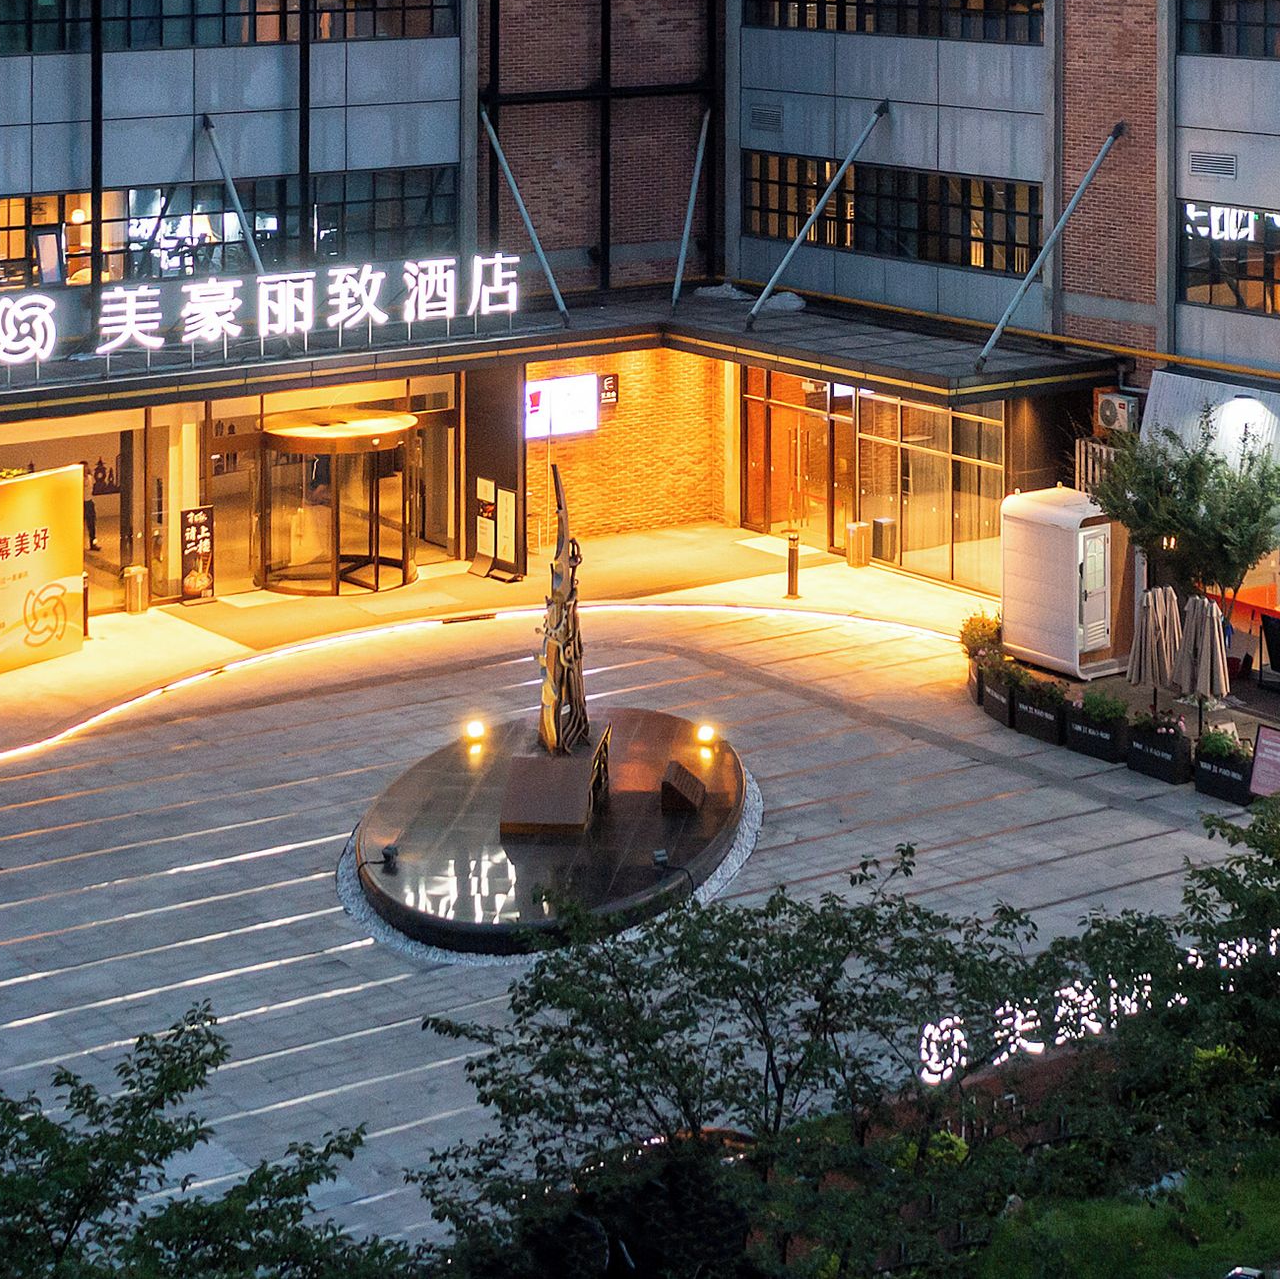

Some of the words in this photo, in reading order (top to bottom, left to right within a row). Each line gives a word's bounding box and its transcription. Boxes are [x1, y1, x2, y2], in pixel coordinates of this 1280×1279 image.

[96, 252, 521, 354] 美豪丽致酒店
